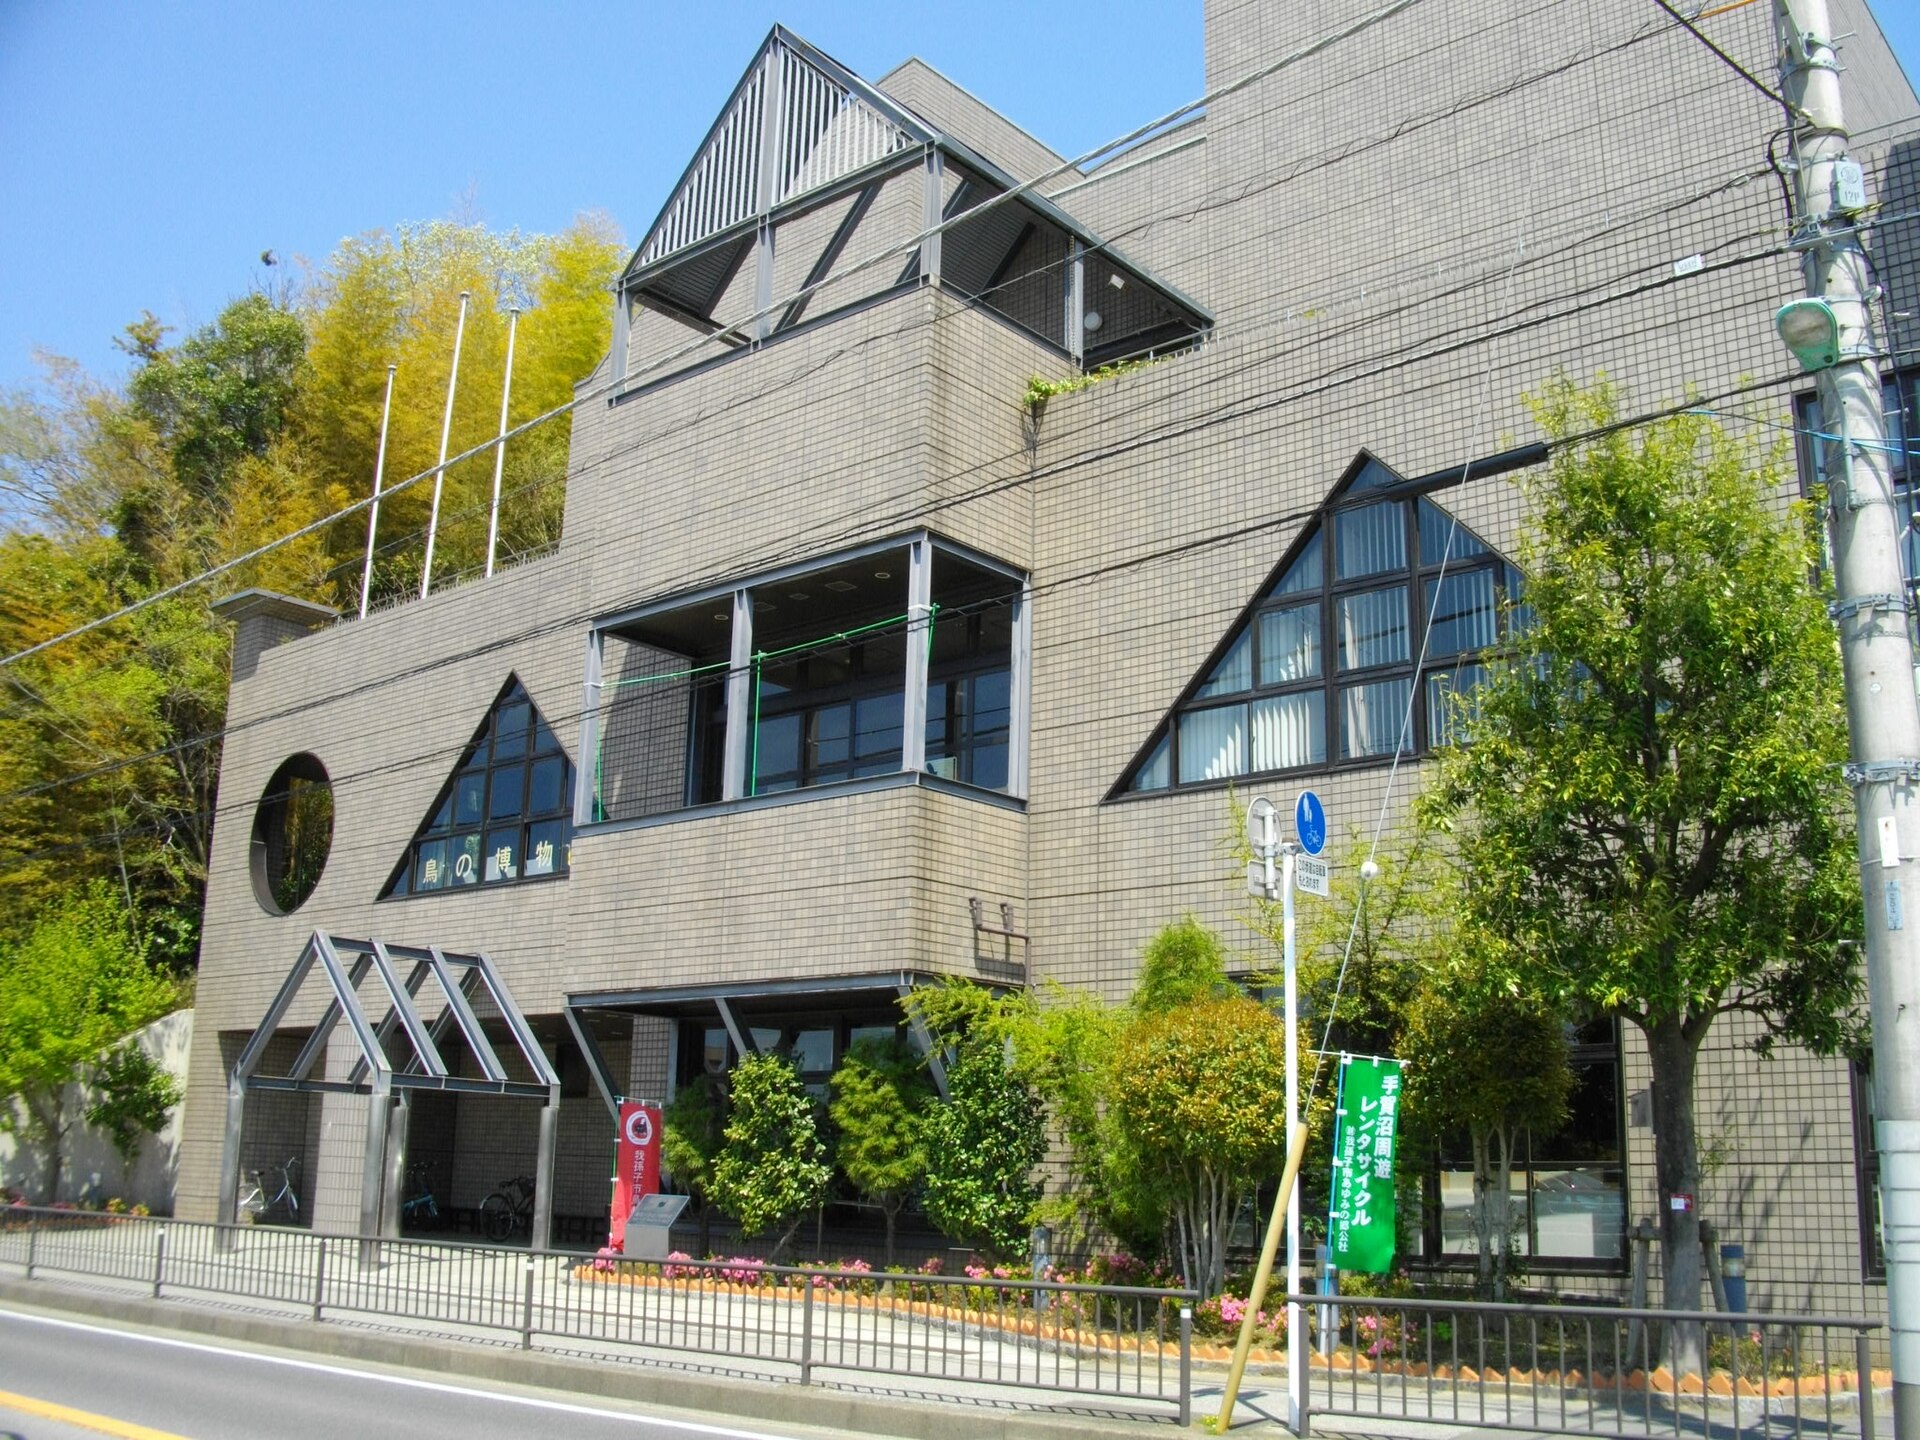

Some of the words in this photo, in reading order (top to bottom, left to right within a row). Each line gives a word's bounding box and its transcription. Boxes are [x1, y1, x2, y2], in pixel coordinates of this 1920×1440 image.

[422, 840, 570, 884] 鳥の博物
[1351, 1096, 1378, 1226] レンタサイクル
[1373, 1075, 1399, 1179] 手賀沼周遊
